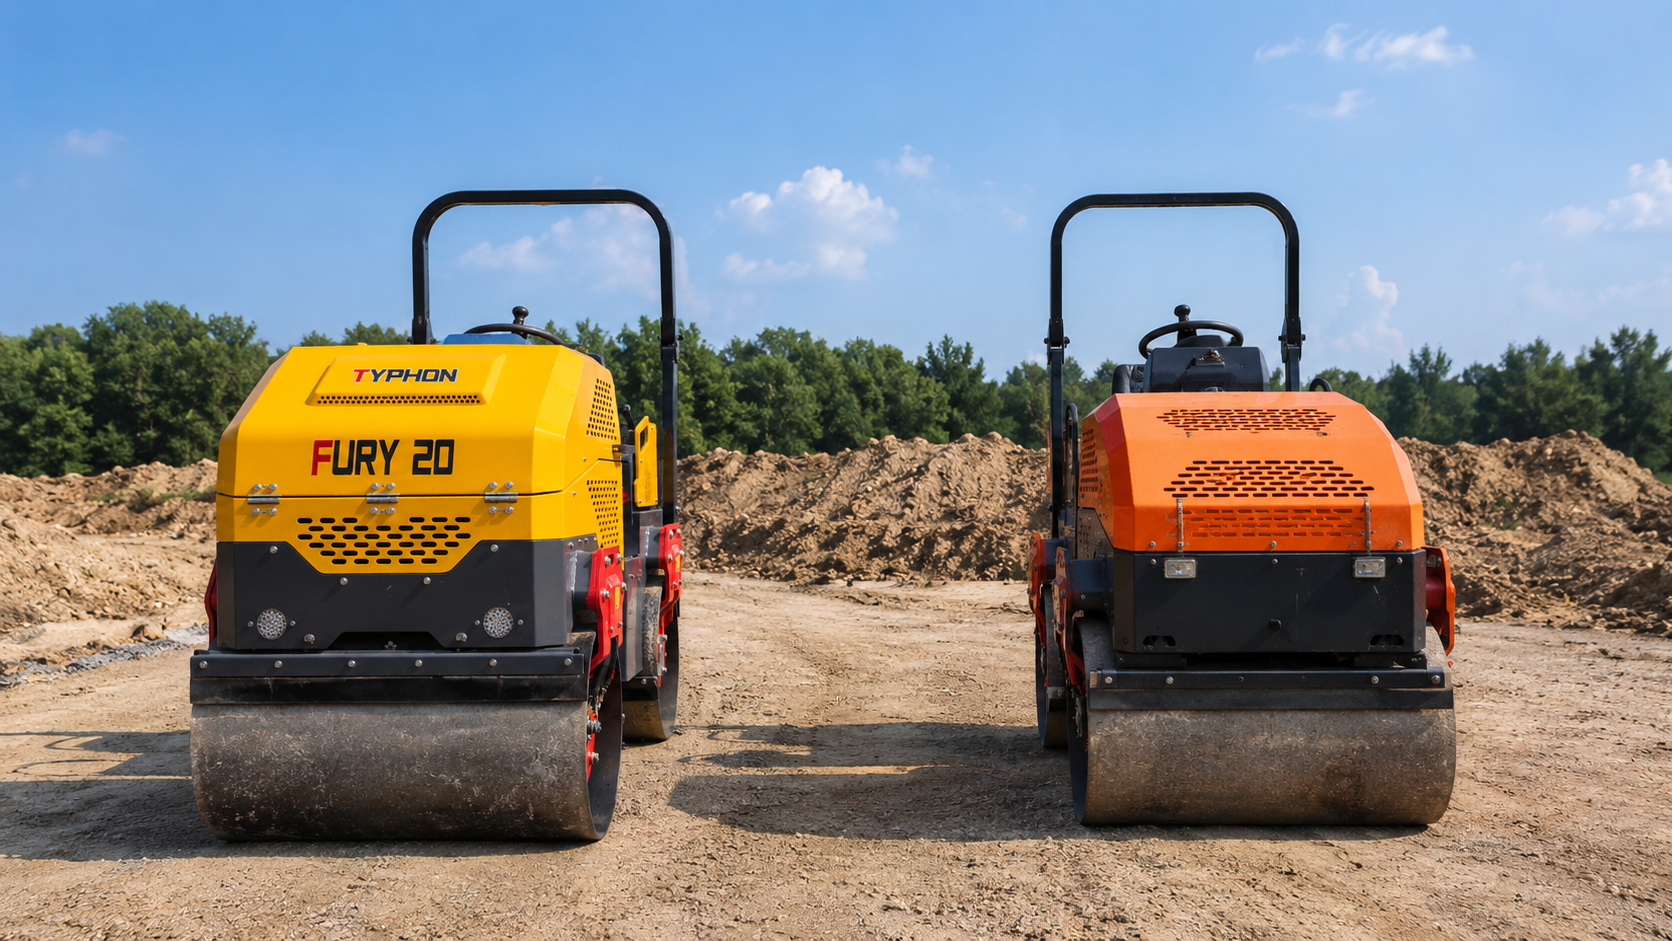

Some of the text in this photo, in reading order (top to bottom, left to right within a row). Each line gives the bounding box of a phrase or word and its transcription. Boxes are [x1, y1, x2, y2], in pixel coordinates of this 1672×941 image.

[353, 368, 458, 383] TYPHON
[311, 439, 455, 475] FURY 20
